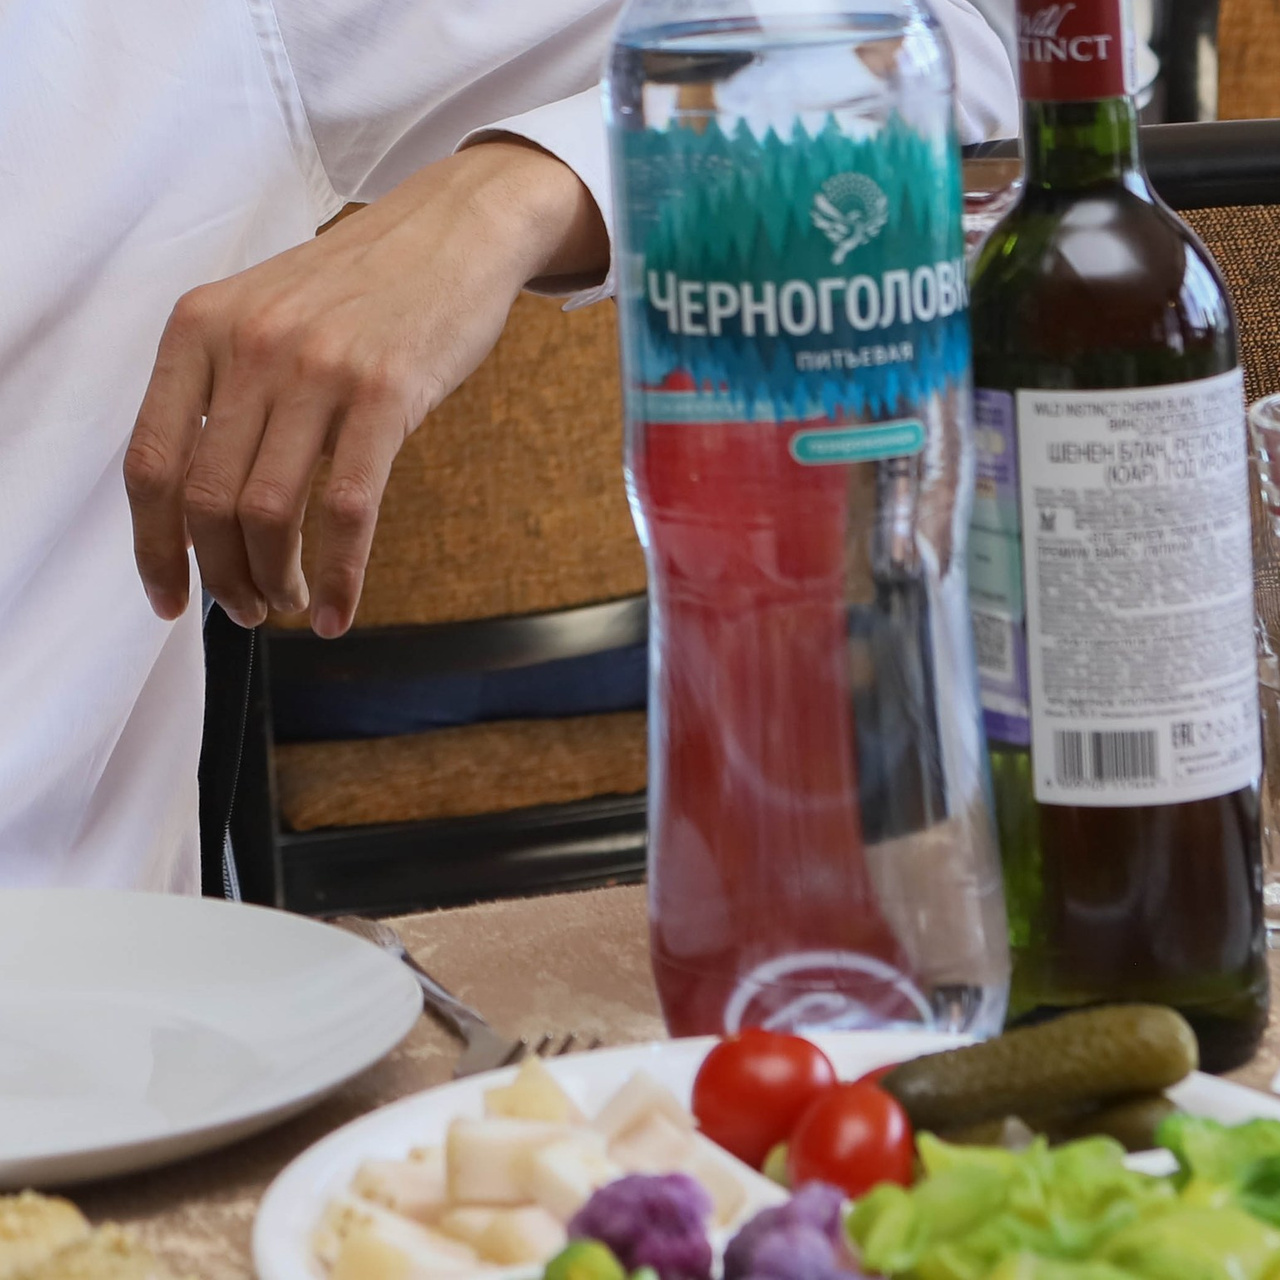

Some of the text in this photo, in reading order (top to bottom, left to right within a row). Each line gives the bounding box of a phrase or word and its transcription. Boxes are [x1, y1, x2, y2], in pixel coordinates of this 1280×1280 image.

[1020, 34, 1113, 62] TINCT
[647, 257, 970, 337] ЧЕРНОГОЛОВК
[795, 340, 914, 372] ПИТЬЕВАЯ
